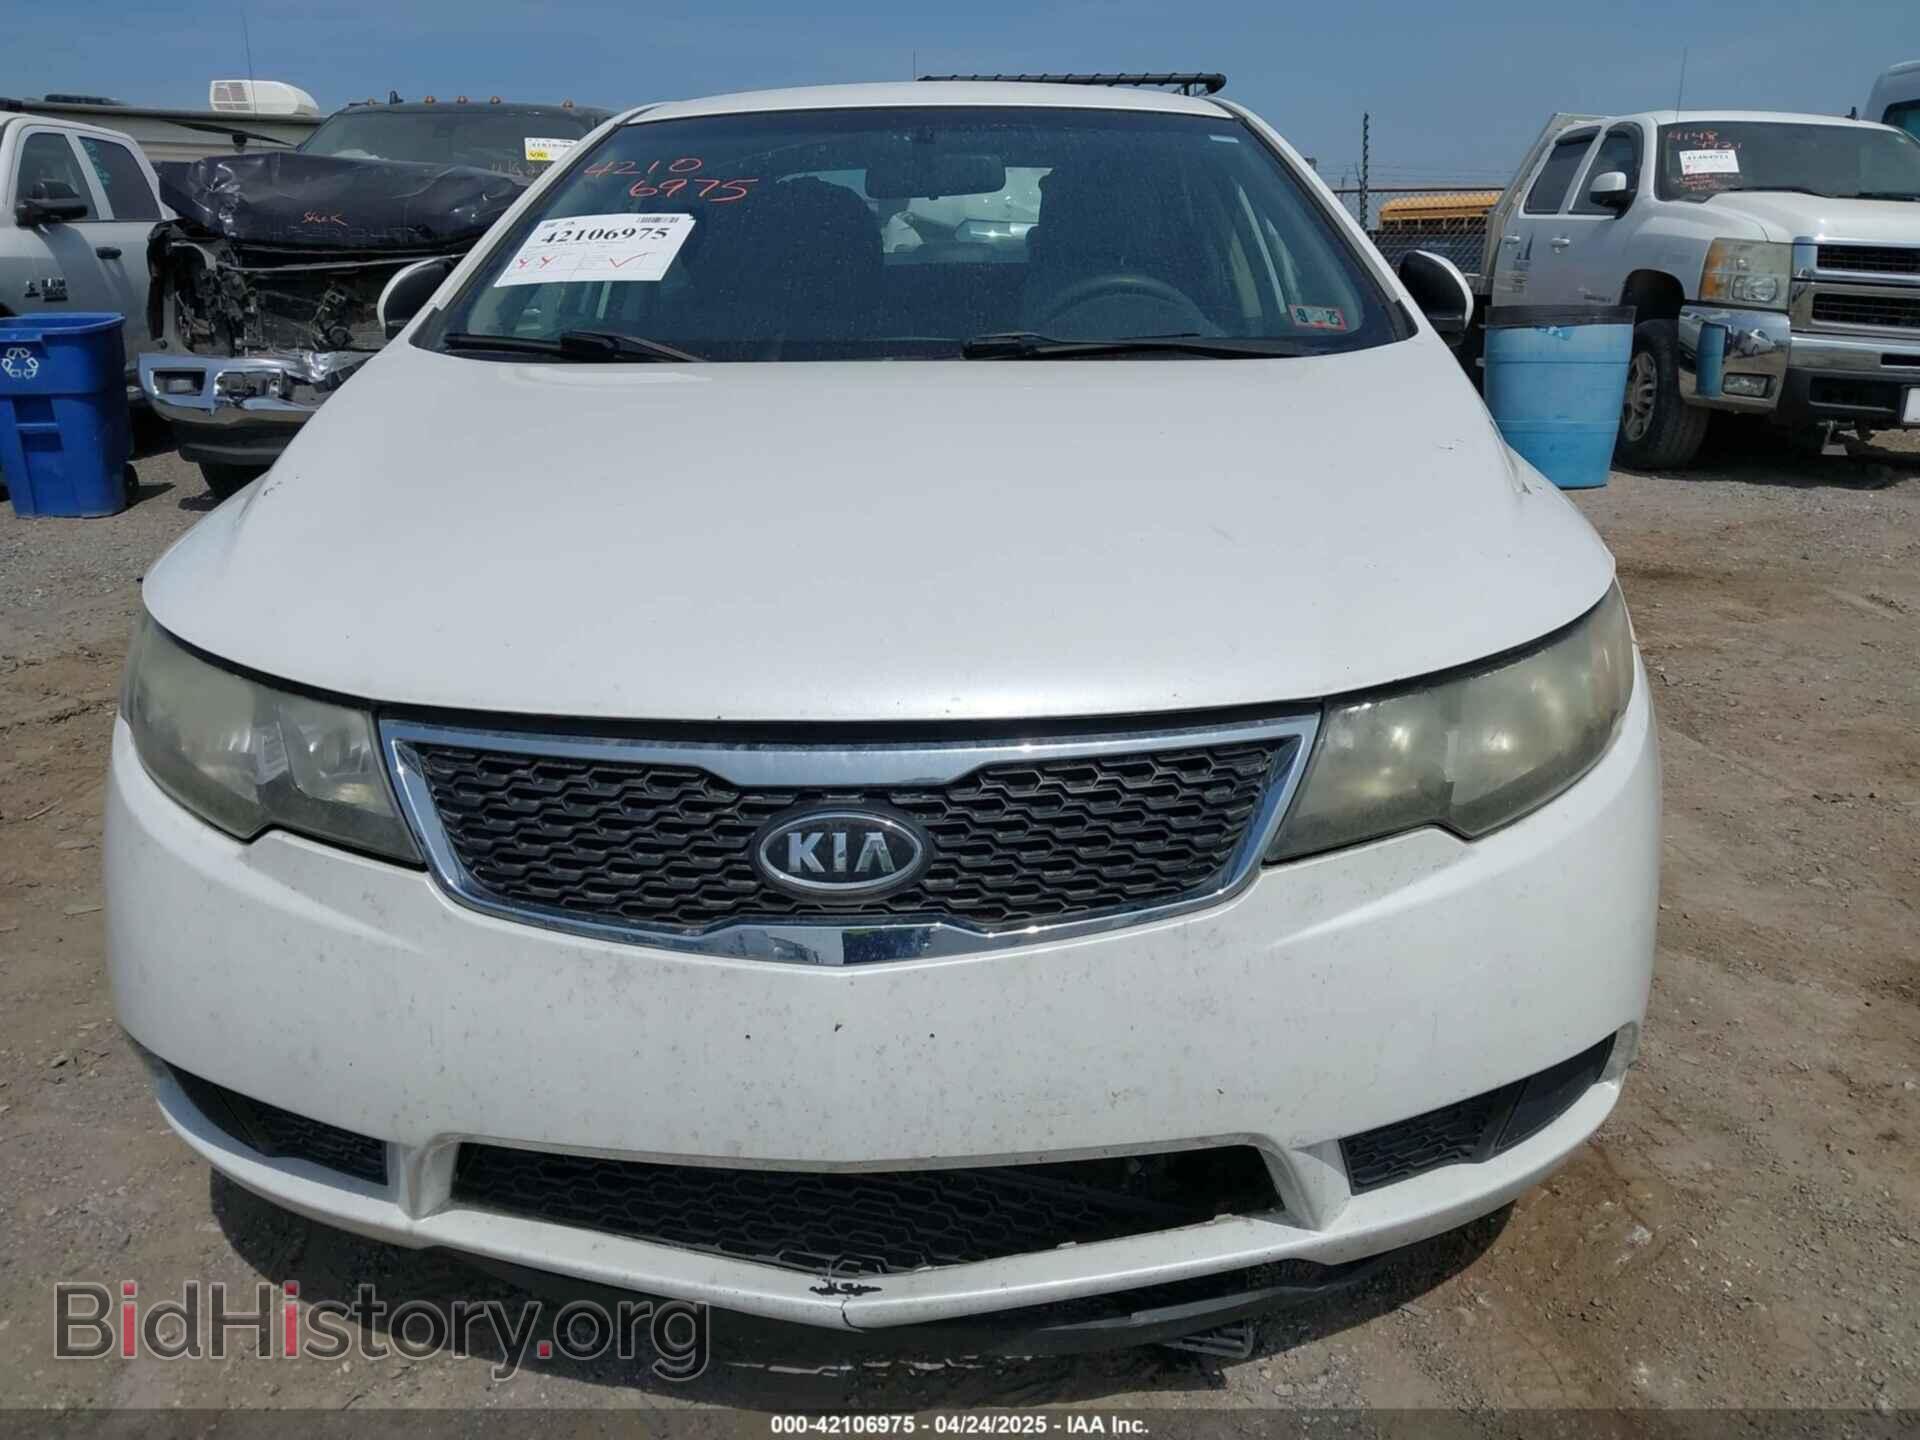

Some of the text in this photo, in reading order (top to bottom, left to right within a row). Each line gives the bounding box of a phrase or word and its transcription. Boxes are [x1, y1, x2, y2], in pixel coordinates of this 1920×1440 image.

[584, 157, 702, 177] 4210
[629, 177, 759, 203] 6975
[541, 227, 671, 244] 42106975
[786, 831, 896, 873] KIA
